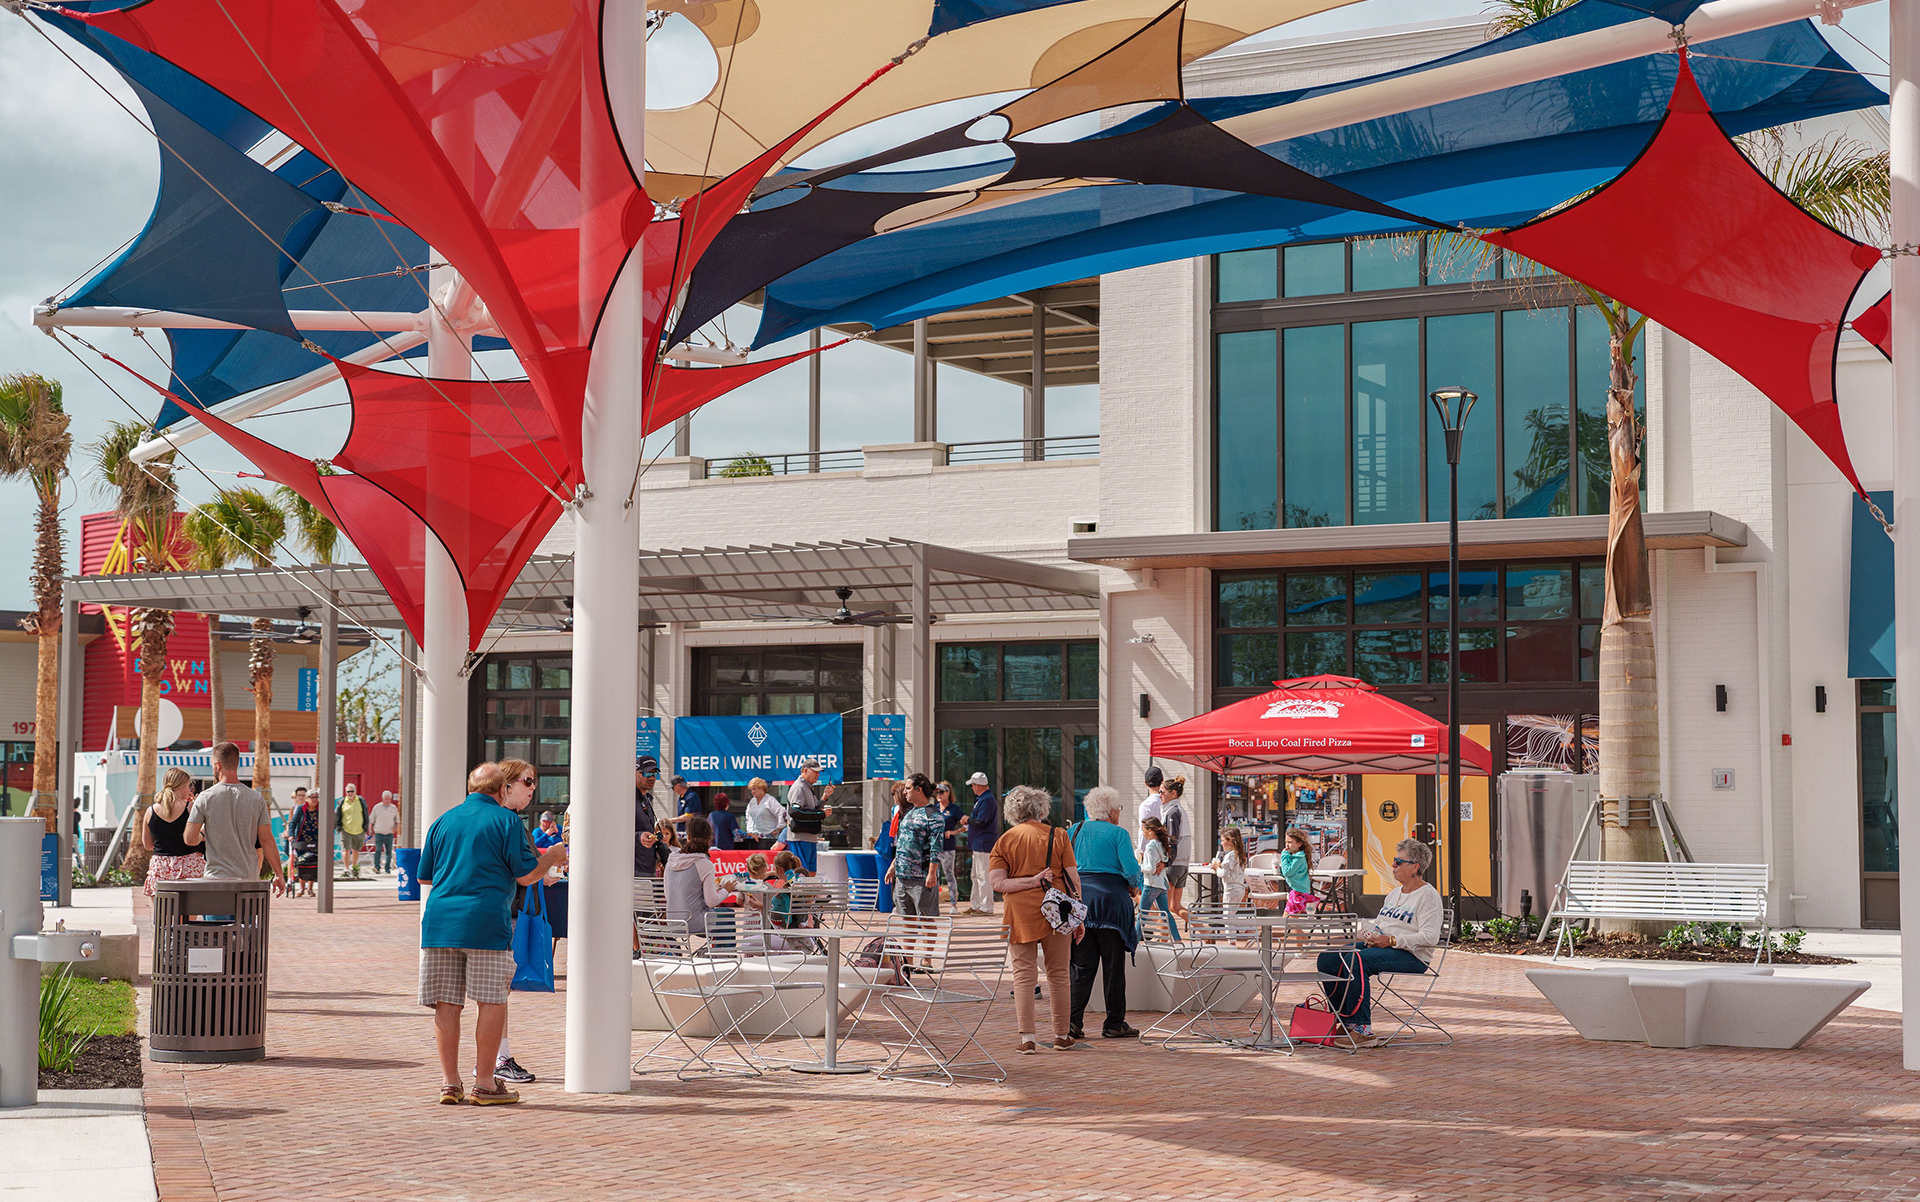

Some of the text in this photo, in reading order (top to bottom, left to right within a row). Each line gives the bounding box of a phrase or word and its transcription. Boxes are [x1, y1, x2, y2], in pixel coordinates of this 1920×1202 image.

[1228, 737, 1353, 750] Bocca Lupo Coal Fired Pizza
[681, 756, 719, 770] BEER
[731, 755, 771, 769] WINE
